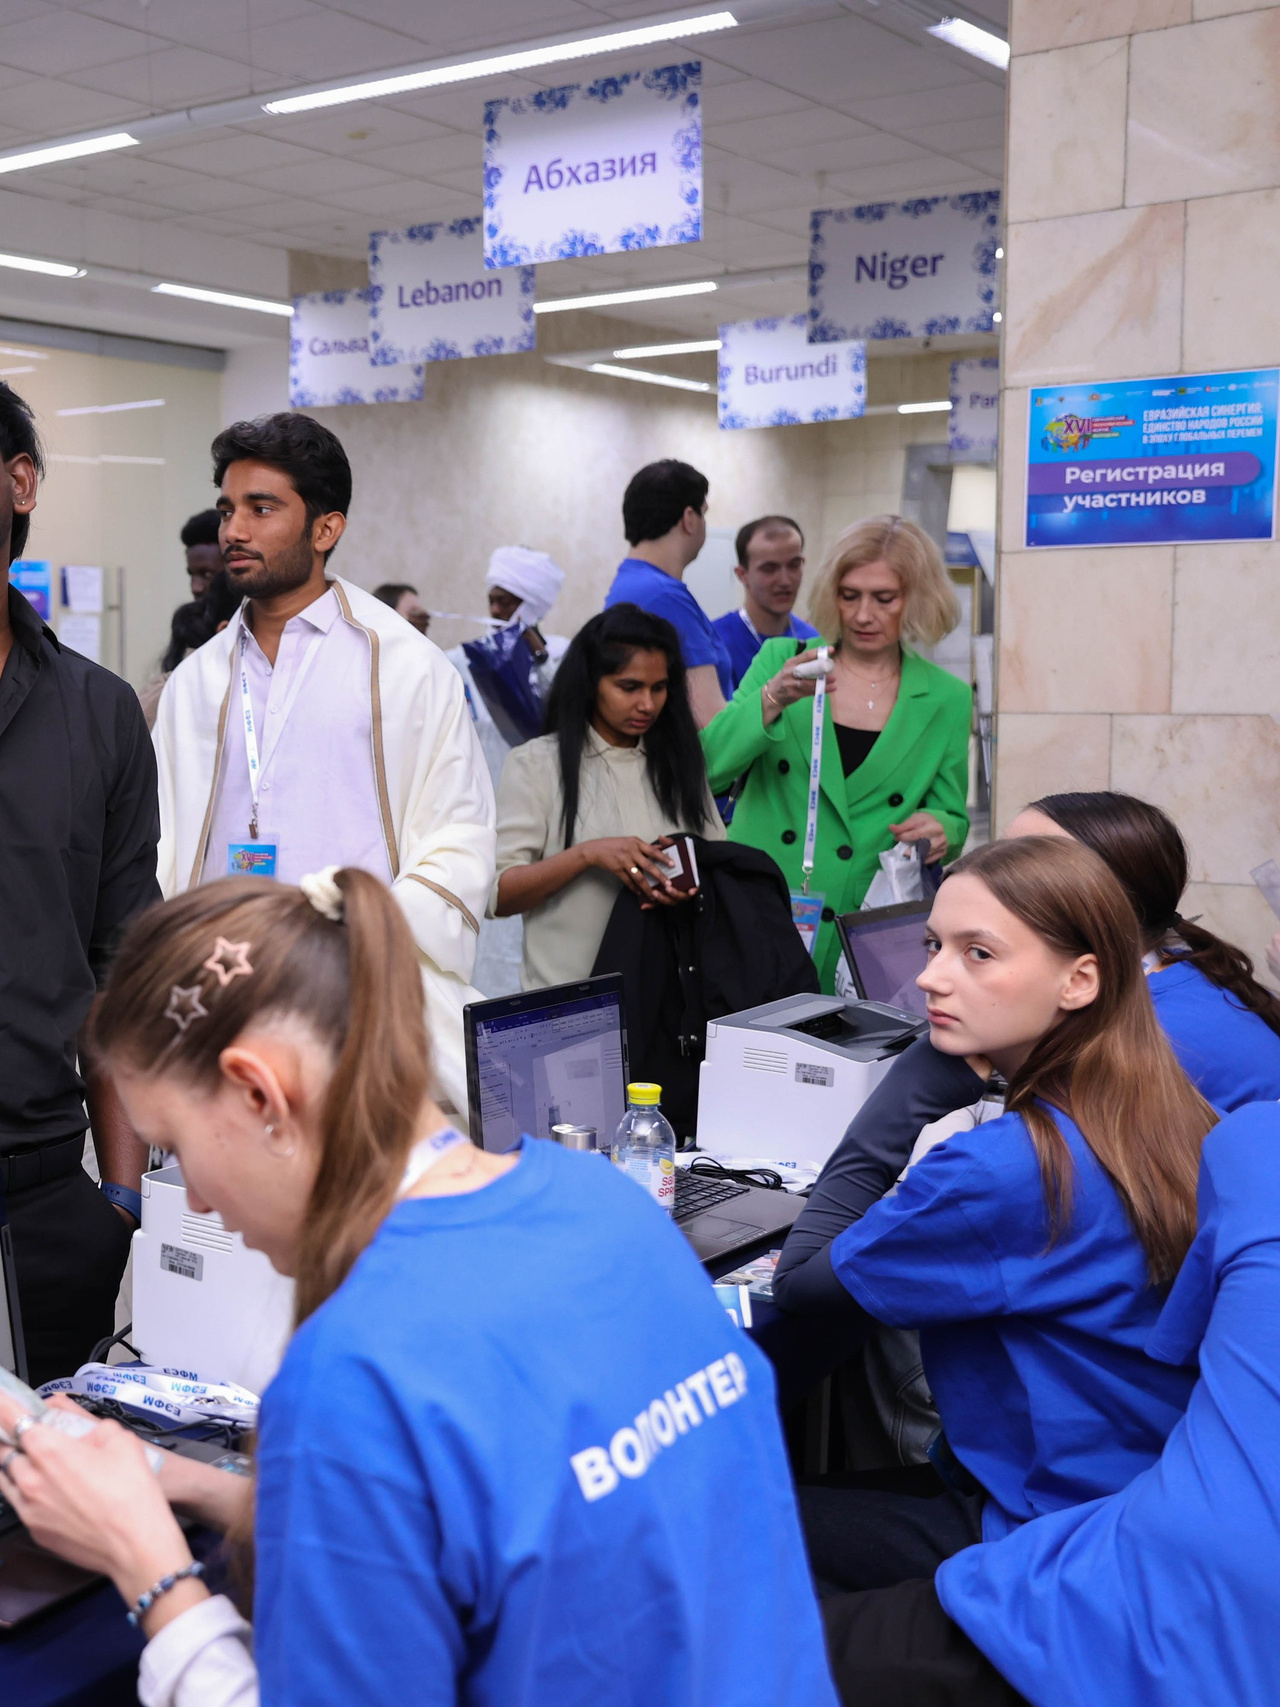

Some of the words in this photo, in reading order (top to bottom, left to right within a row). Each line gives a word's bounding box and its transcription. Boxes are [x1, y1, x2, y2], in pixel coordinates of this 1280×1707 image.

[523, 152, 656, 194] Абхазия
[855, 251, 945, 290] Niger
[397, 278, 503, 308] Lebanon
[745, 354, 838, 385] Burundi
[1063, 418, 1091, 434] XVI
[1065, 461, 1225, 484] Регистрация
[1062, 488, 1207, 514] участников
[41, 1380, 73, 1393] ЕЭФМ
[163, 1368, 198, 1382] ЕЭФМ
[86, 1381, 117, 1396] ЕЭФМ
[170, 1381, 208, 1395] ЕЭФМ
[142, 1394, 182, 1417] ЕЭФМ
[570, 1352, 747, 1503] ВОЛОНТЕР
